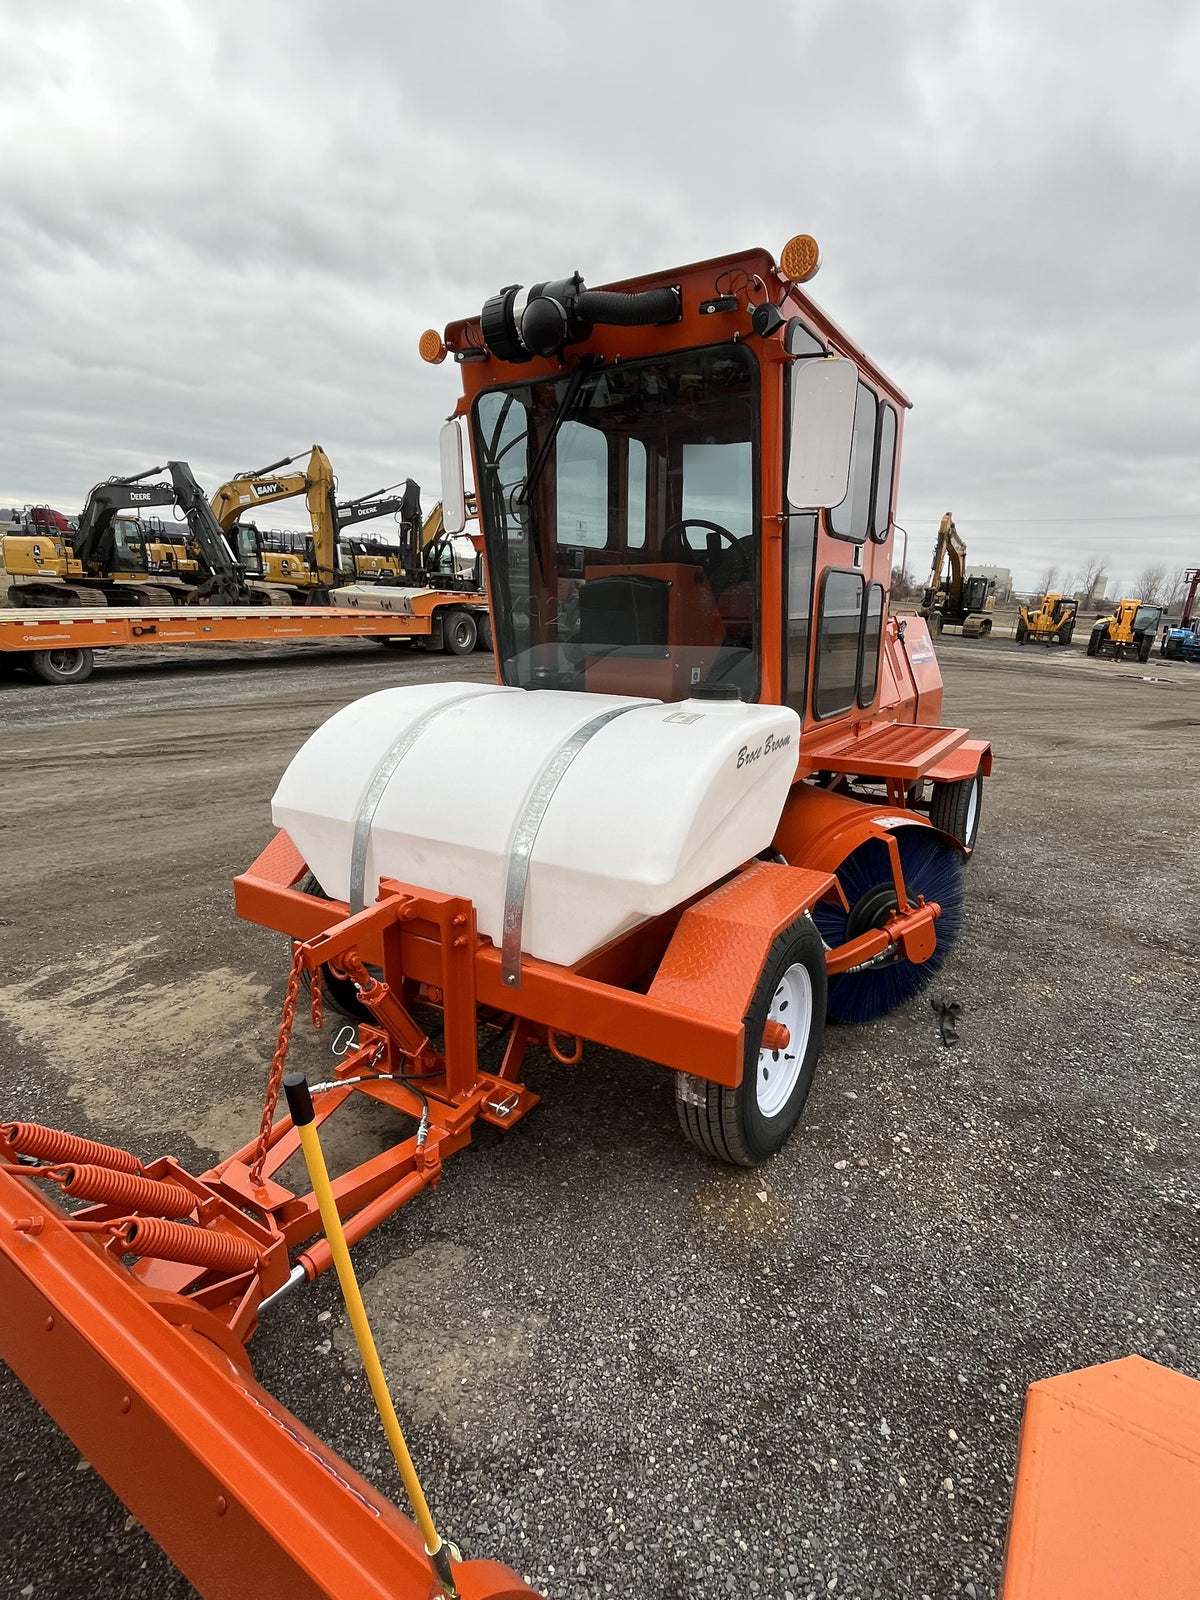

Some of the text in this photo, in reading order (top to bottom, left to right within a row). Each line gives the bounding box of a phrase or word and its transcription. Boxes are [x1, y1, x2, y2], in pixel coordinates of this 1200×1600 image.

[256, 483, 278, 495] SANY
[130, 492, 152, 501] DEERE
[357, 506, 378, 516] DEERE
[764, 733, 791, 755] Broom
